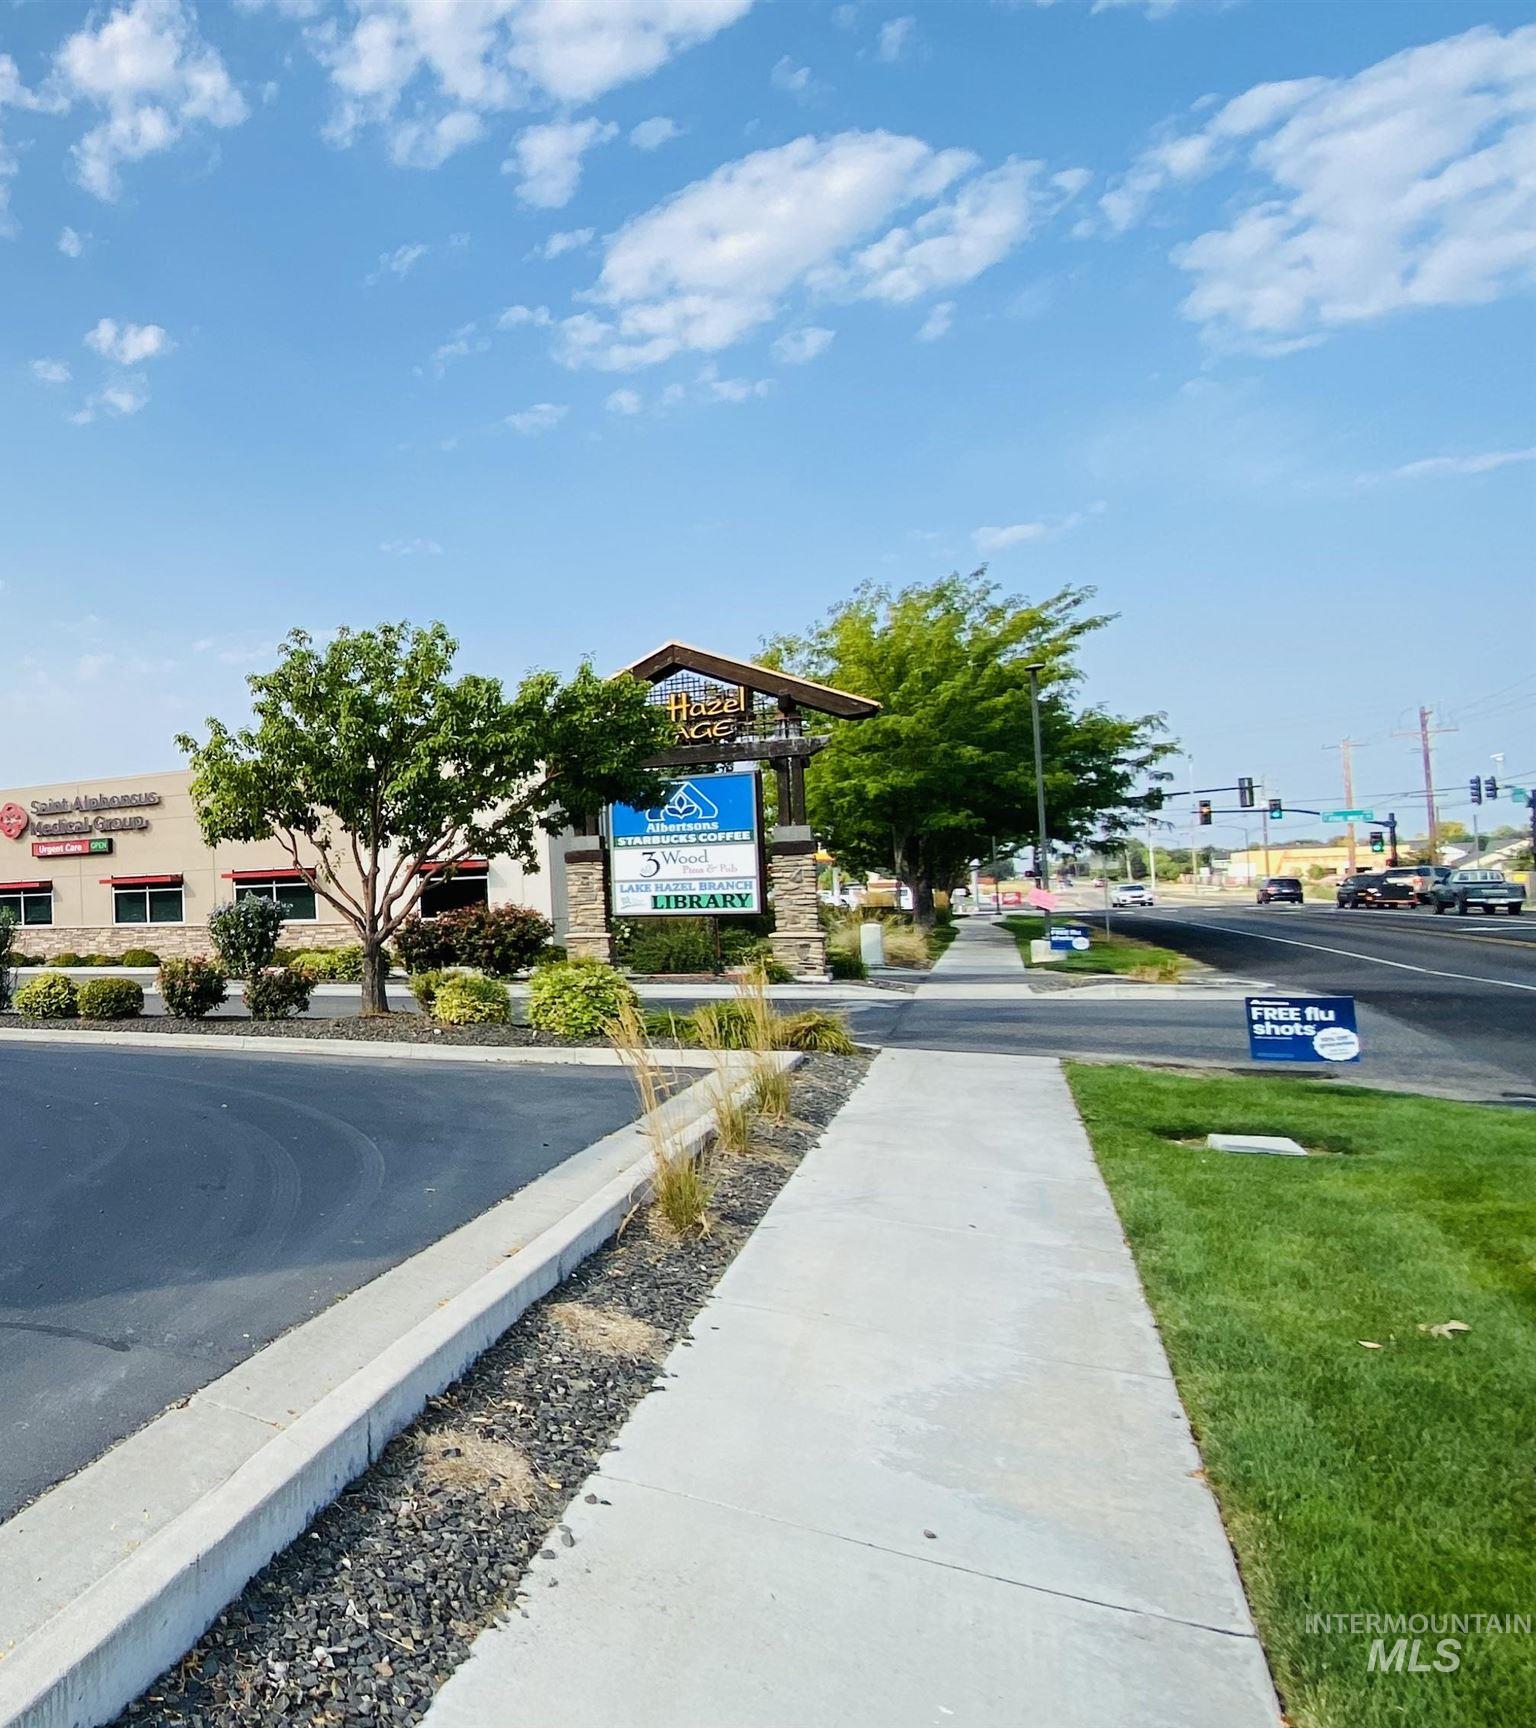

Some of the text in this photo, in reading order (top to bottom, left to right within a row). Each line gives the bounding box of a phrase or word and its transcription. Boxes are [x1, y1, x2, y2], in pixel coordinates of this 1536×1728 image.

[667, 686, 745, 722] Hazel
[31, 792, 160, 815] Saint Alphonsus
[31, 817, 91, 836] Medical
[94, 816, 148, 832] Group
[646, 822, 720, 833] Albertsons
[90, 841, 108, 850] OPEN
[617, 831, 751, 847] STARBUCKS COFFEE
[39, 843, 82, 855] Urgent Care
[639, 849, 709, 878] 3 Wood
[720, 863, 739, 873] Pub
[620, 880, 753, 893] LAKE HAZEL BRANCH
[651, 893, 751, 910] LIBRARY
[1251, 1006, 1335, 1021] FREE flu
